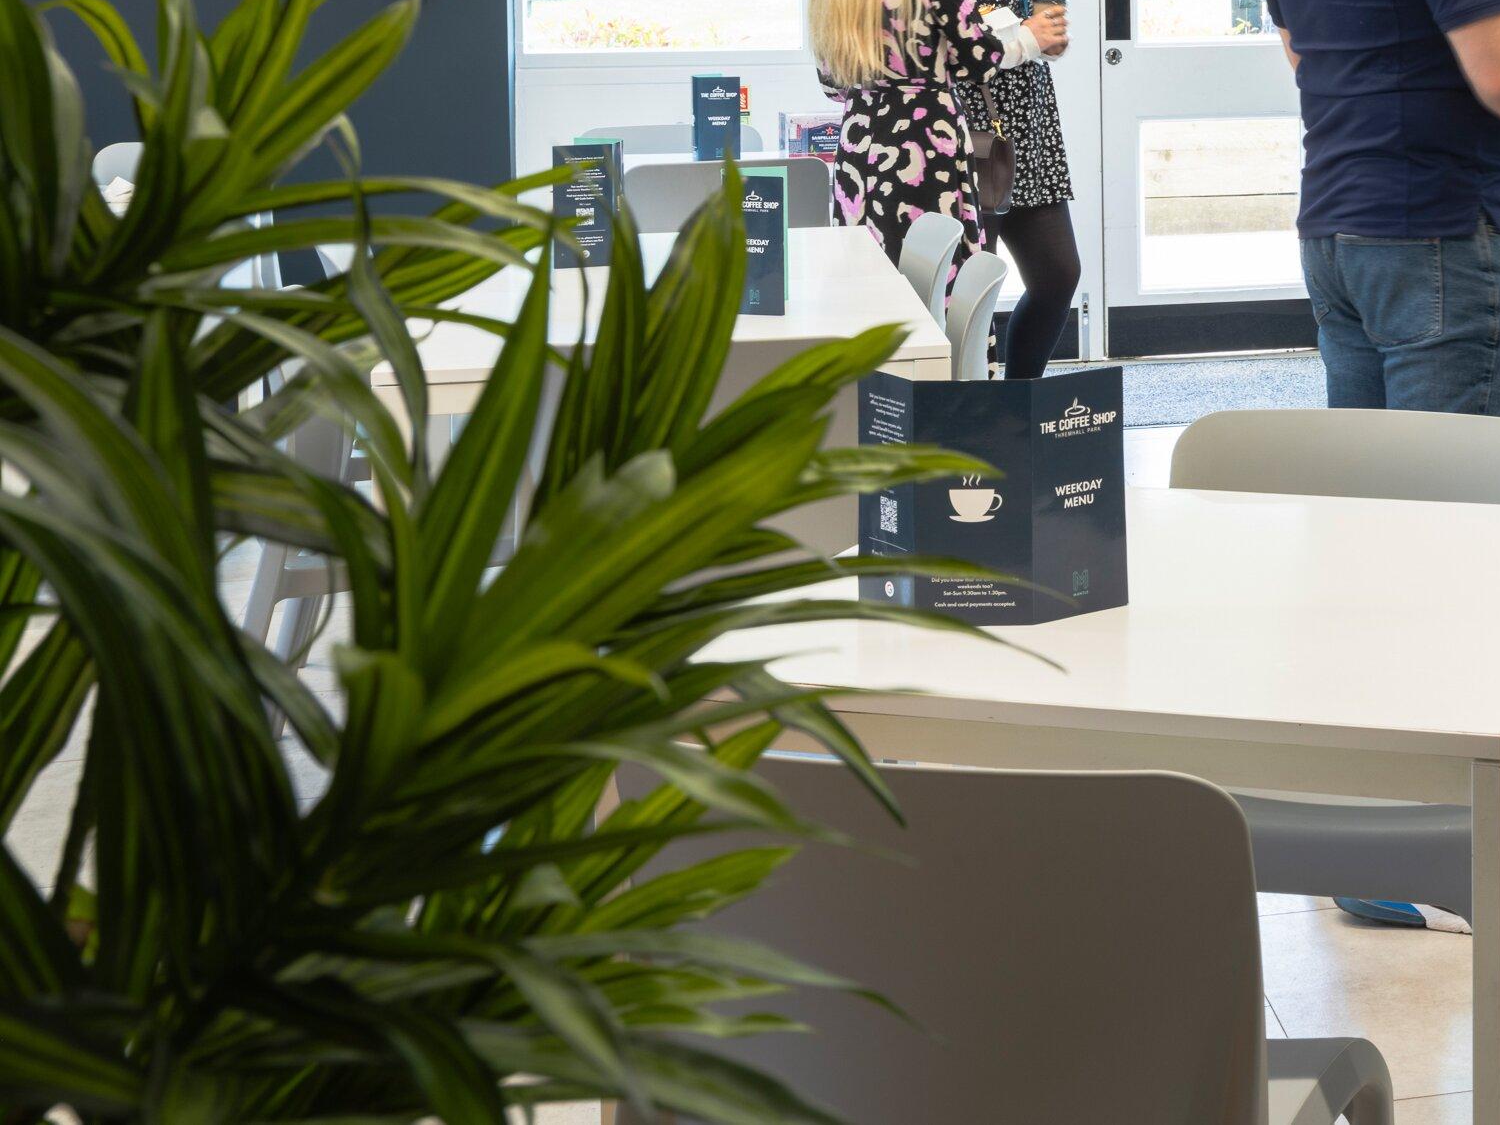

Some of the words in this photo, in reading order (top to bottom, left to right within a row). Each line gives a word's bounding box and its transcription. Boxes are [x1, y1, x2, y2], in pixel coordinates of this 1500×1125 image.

[1040, 421, 1056, 434] THE
[1059, 415, 1090, 431] COFFEE
[1093, 411, 1116, 425] SHOP
[1055, 478, 1103, 496] WEEKDAY
[1064, 494, 1094, 508] MENU
